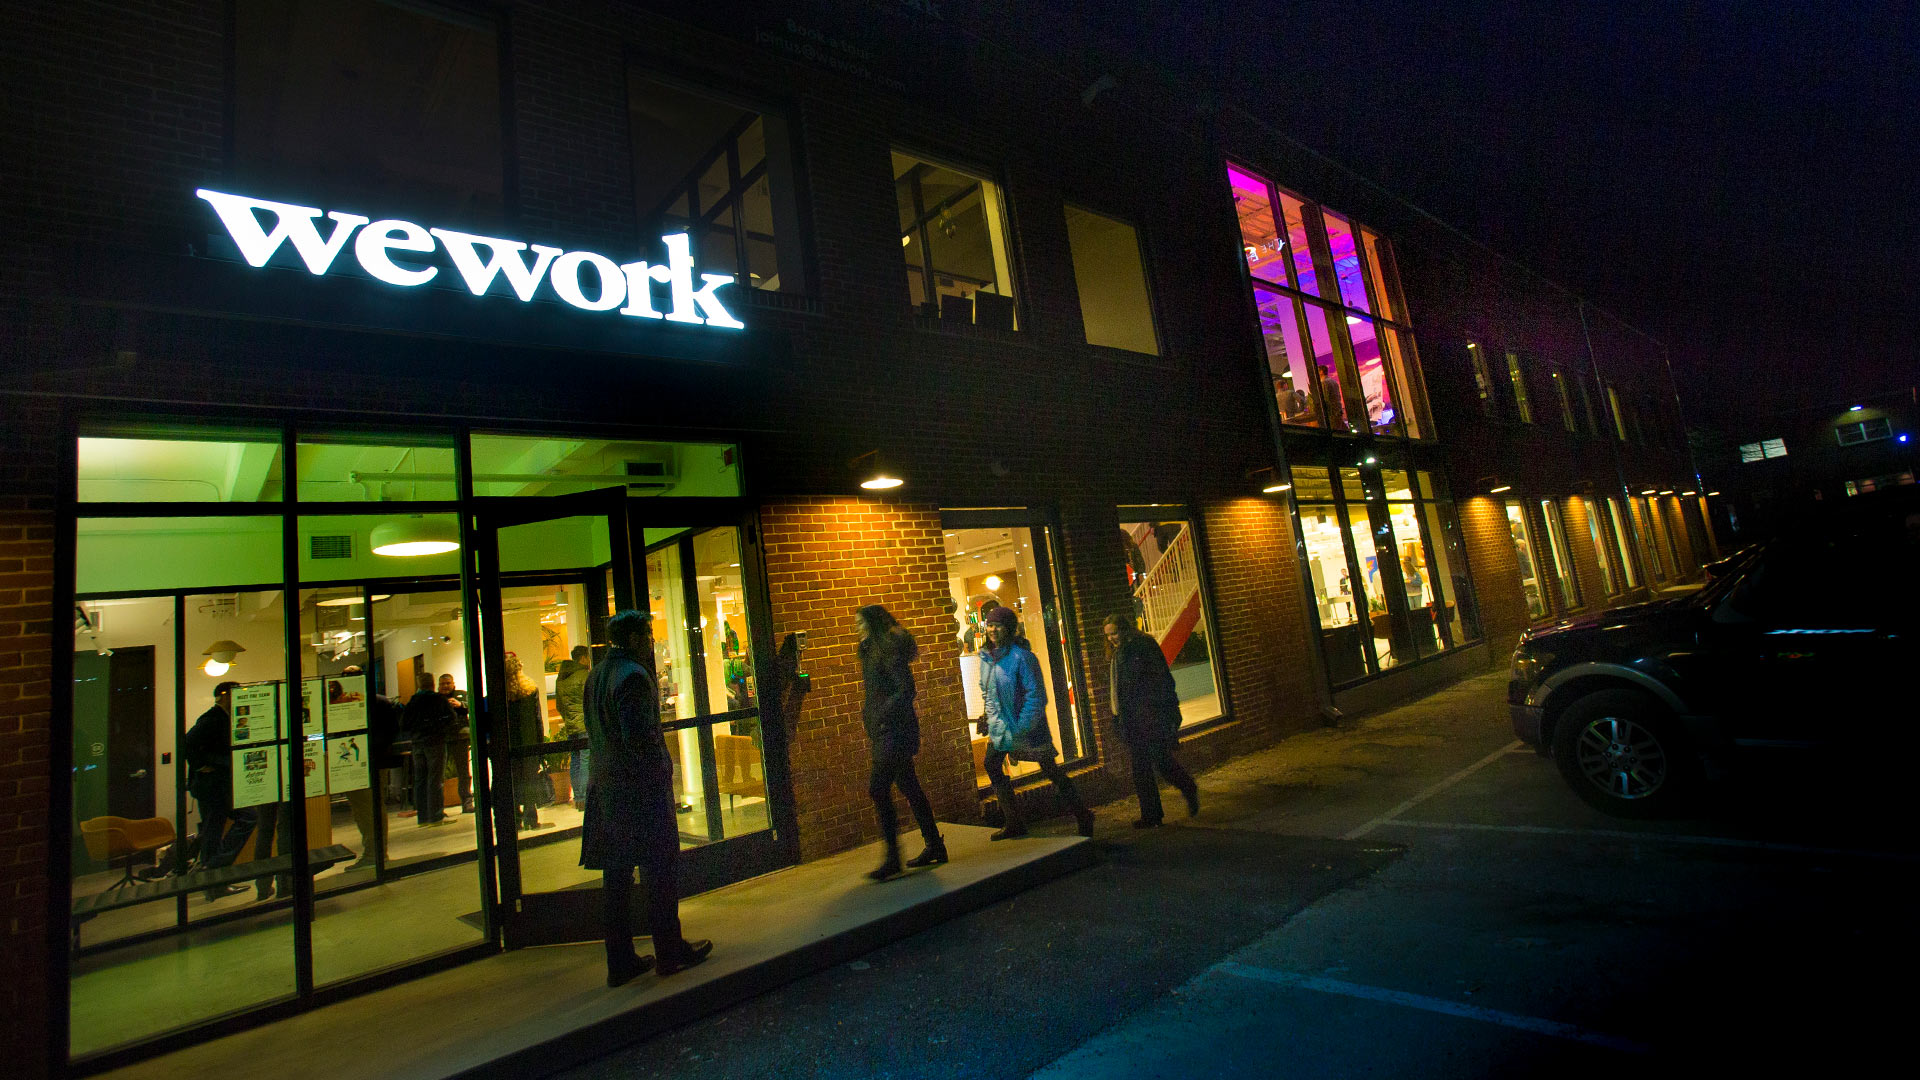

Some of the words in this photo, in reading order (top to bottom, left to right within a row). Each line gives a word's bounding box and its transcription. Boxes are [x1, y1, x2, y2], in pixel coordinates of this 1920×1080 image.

[786, 18, 825, 44] Book
[840, 39, 874, 60] tour
[196, 188, 745, 329] wework
